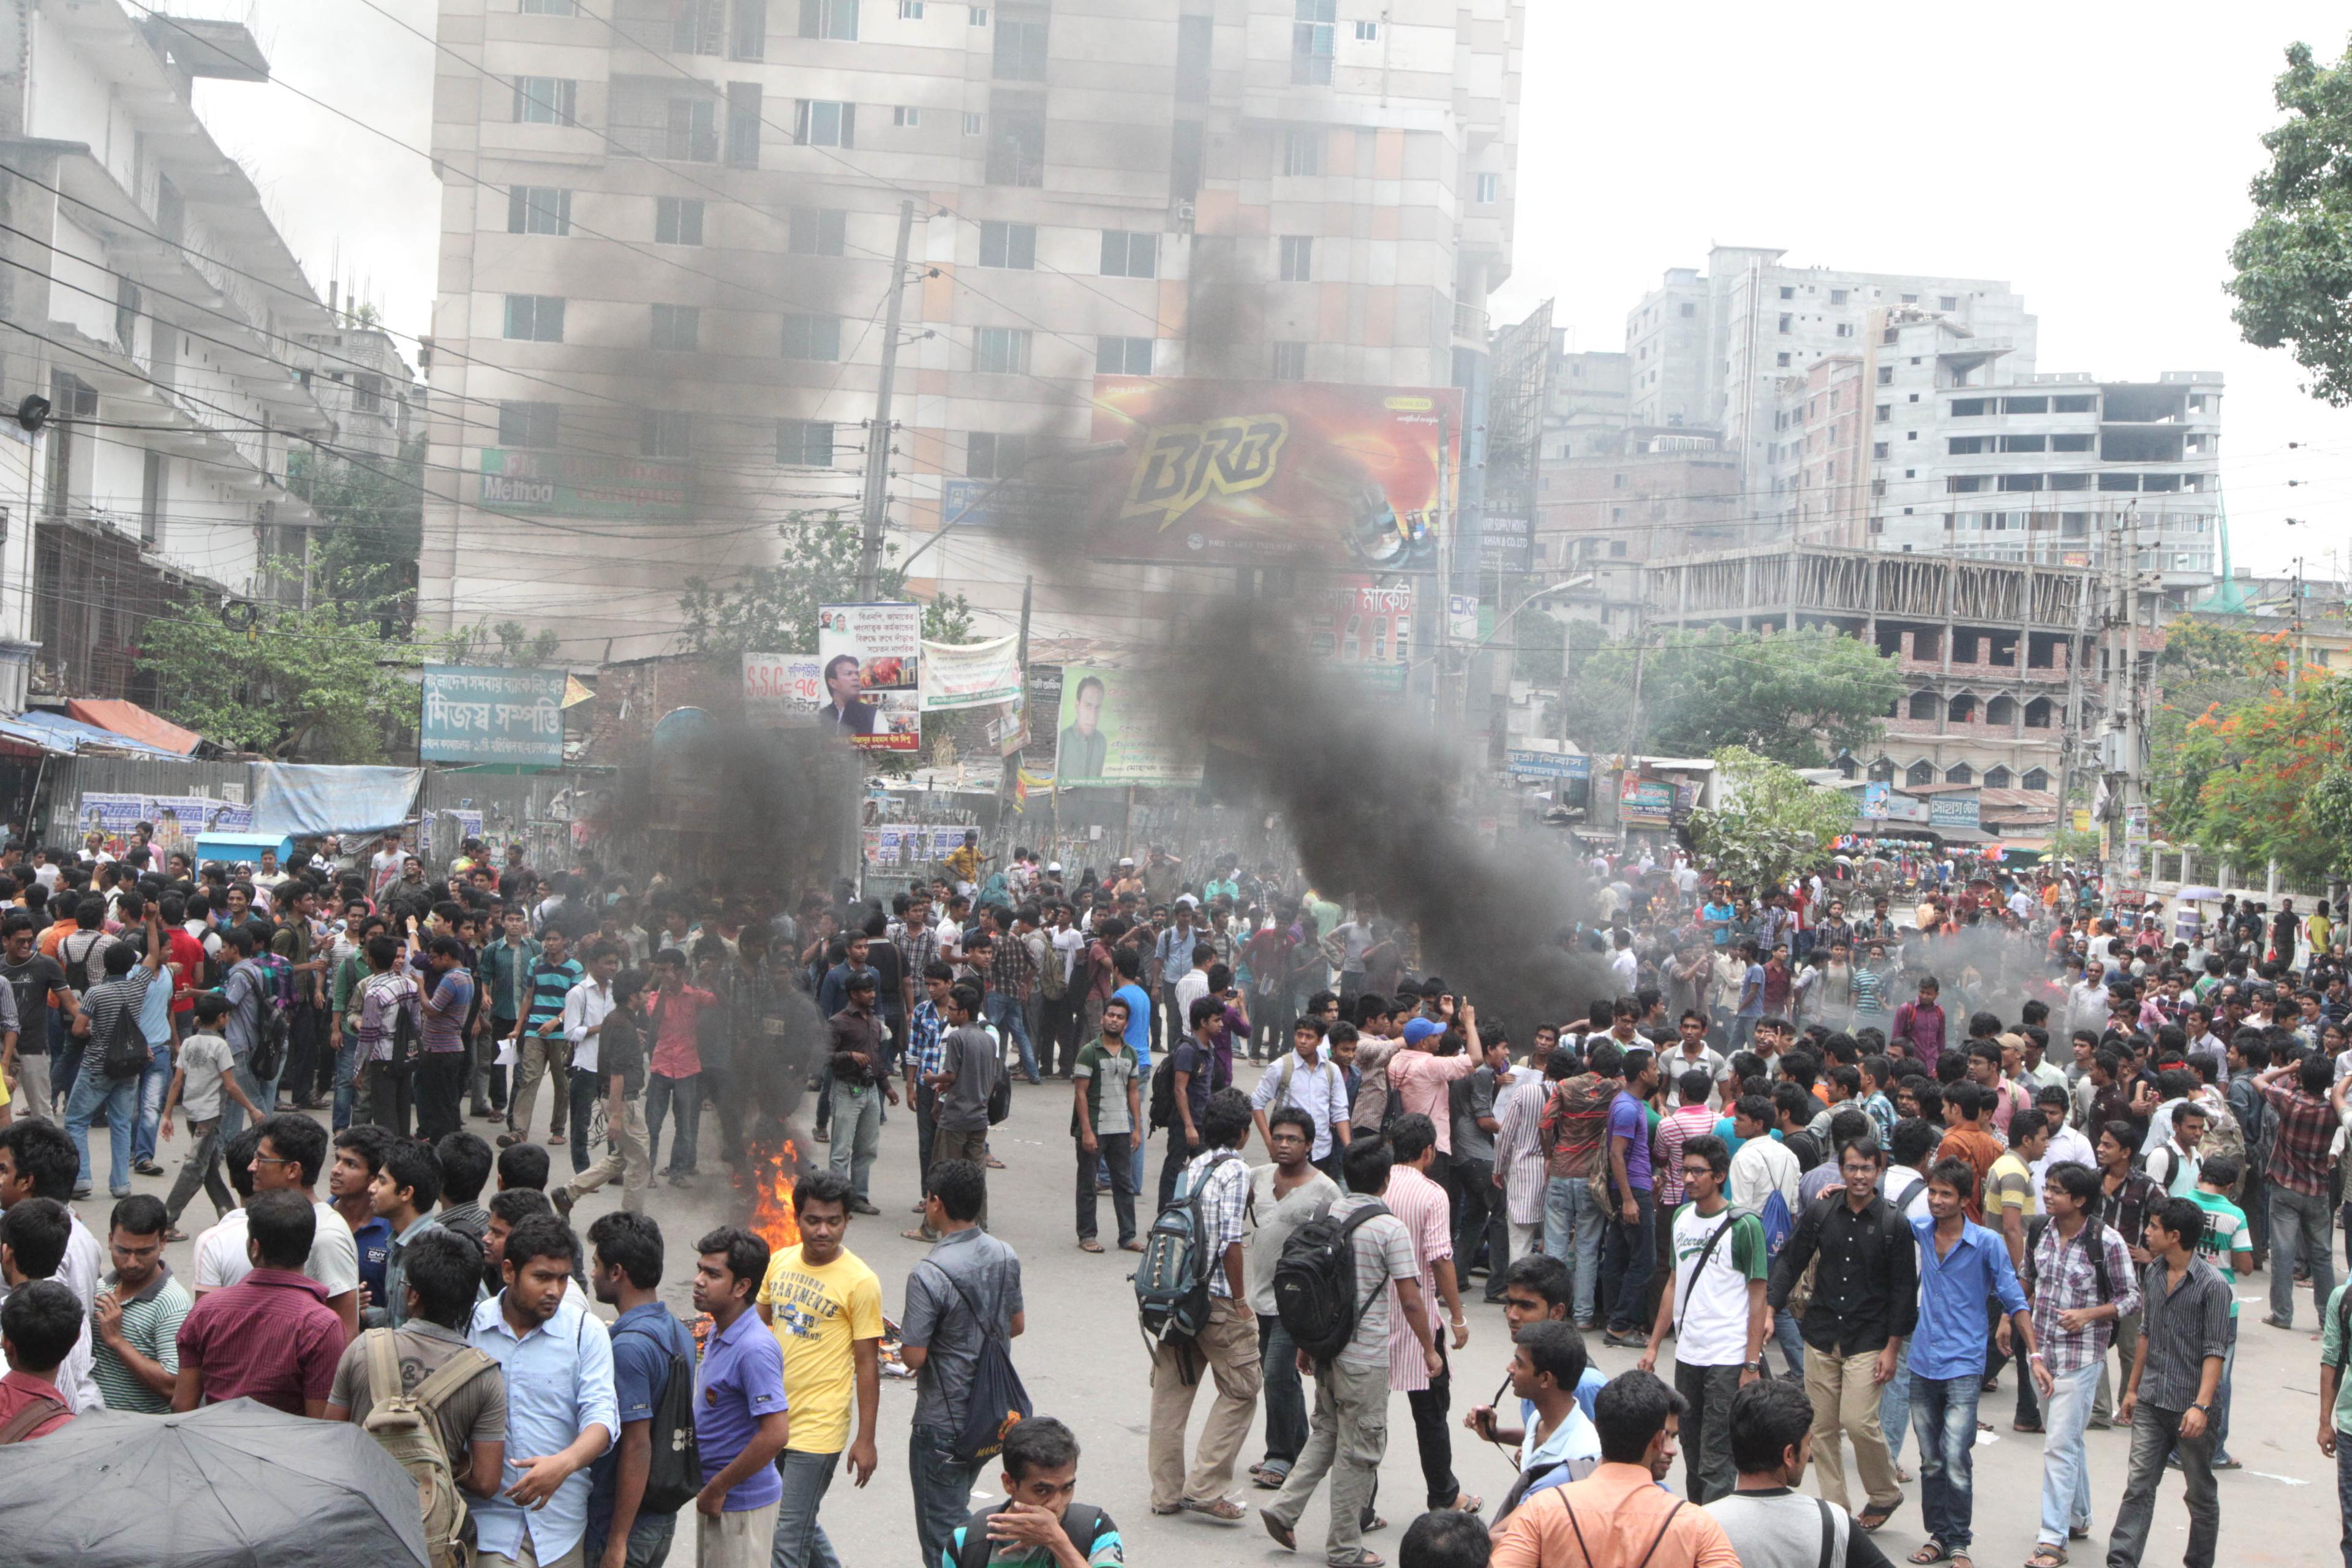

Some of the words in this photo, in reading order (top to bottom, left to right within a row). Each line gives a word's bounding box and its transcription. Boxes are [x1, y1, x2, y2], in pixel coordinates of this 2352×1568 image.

[1136, 421, 1283, 505] BRB
[483, 475, 553, 502] Method
[1483, 535, 1500, 546] KHAN
[1362, 578, 1411, 614] মার্কেট
[891, 644, 914, 654] নাগরিক
[494, 696, 560, 734] সম্পত্তি
[1539, 753, 1583, 767] নিবাস
